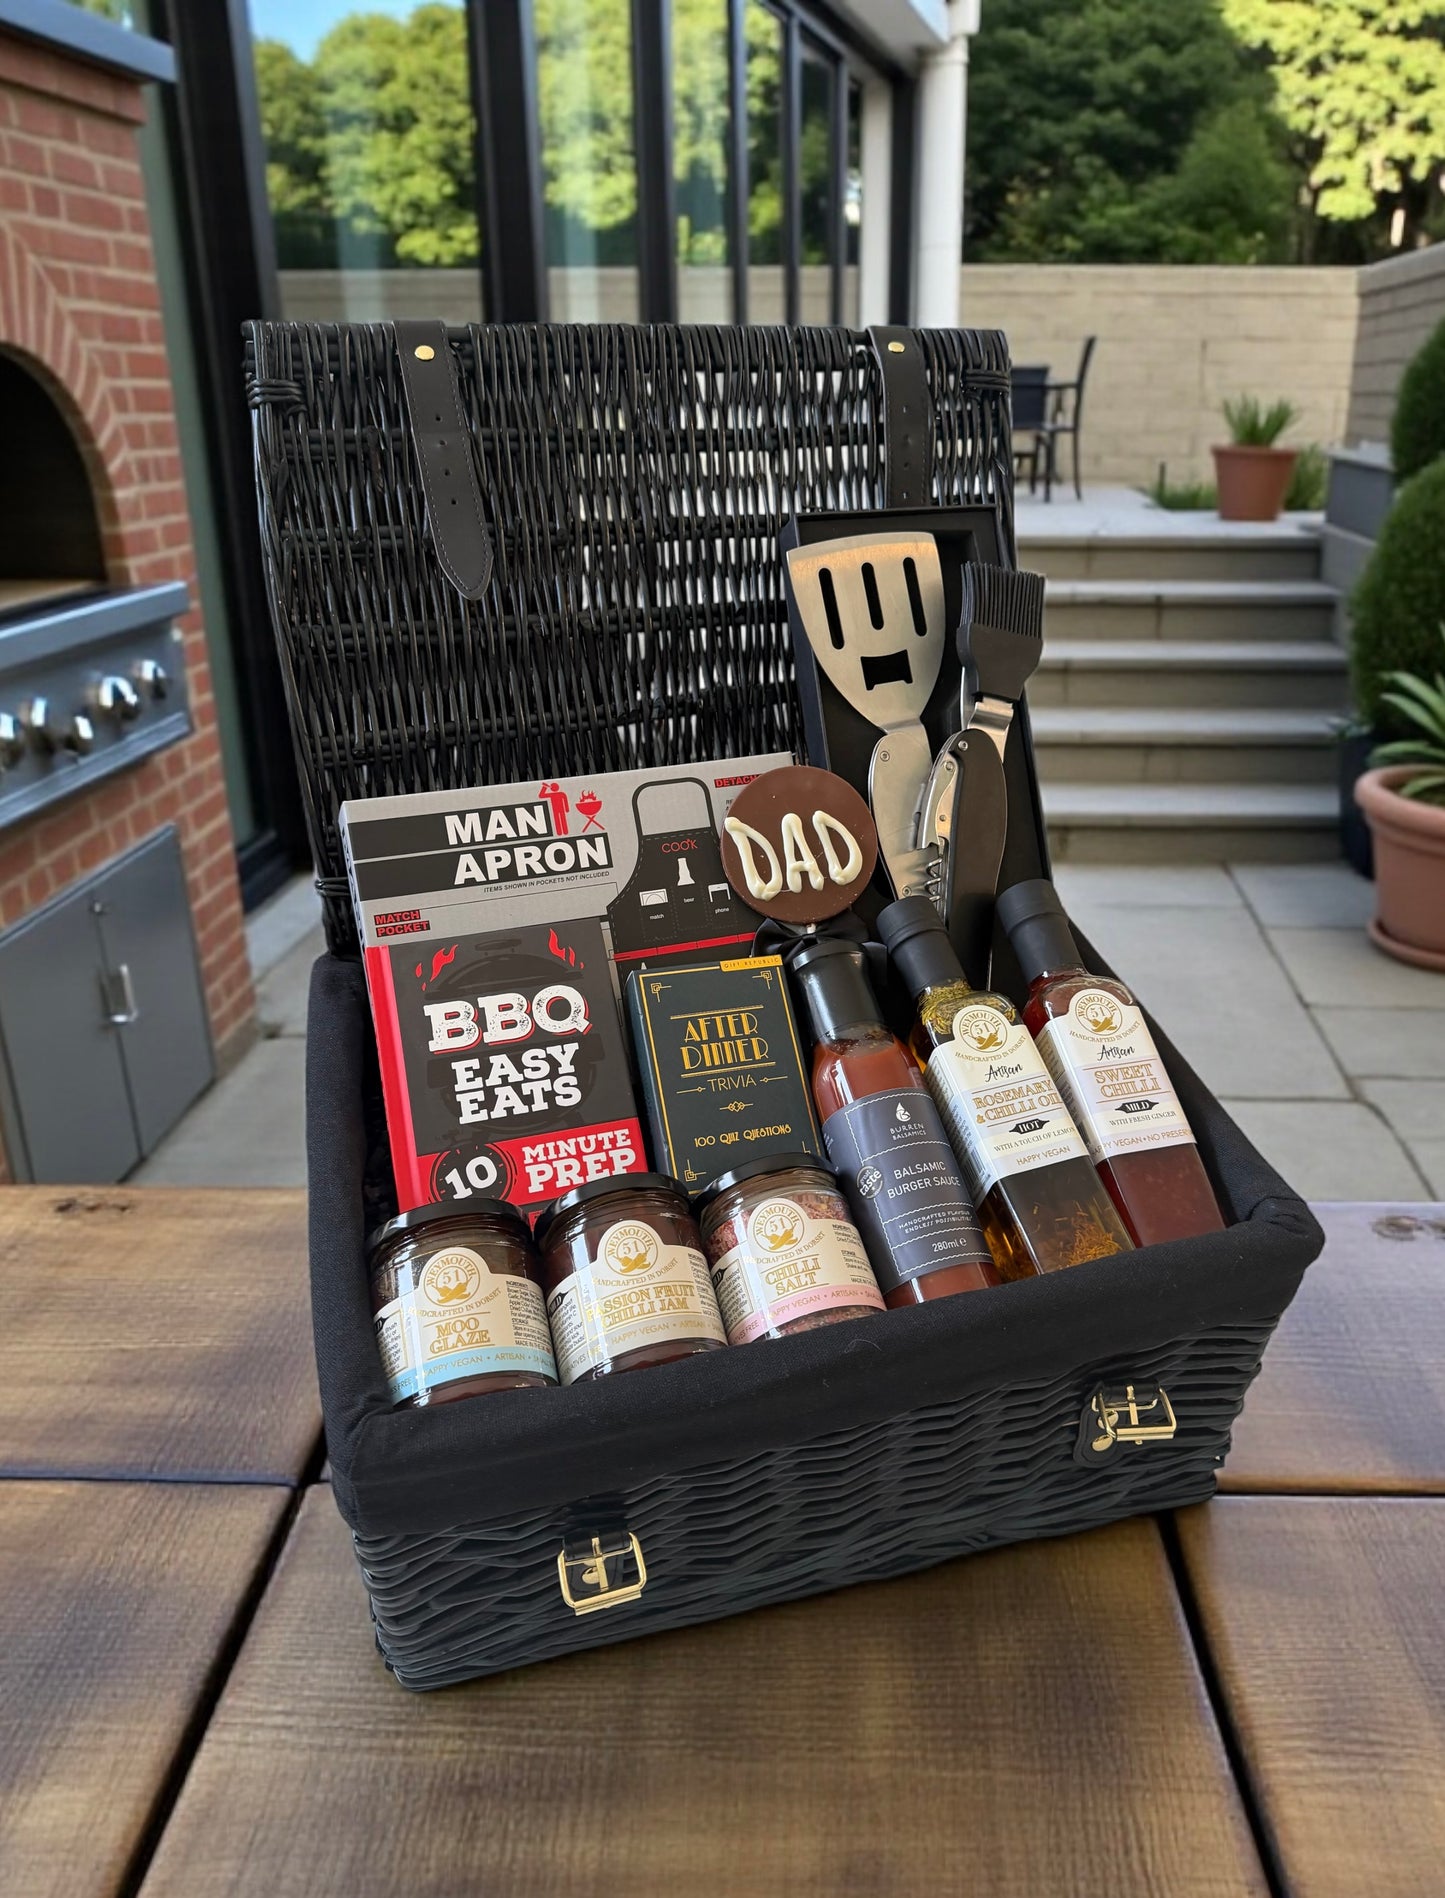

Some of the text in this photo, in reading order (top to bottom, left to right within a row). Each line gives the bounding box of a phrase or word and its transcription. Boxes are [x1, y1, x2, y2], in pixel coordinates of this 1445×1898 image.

[445, 805, 548, 845] MAN
[661, 839, 698, 853] COOK
[724, 810, 863, 901] DAD
[454, 837, 609, 885] APRON
[504, 882, 528, 890] SHOWN
[536, 877, 565, 886] POCKETS
[579, 871, 610, 880] INCLUDED
[375, 911, 420, 925] MATCH
[715, 906, 730, 914] phone
[377, 922, 429, 936] POCKET
[723, 957, 780, 970] GIFT REPUBLIC
[1077, 996, 1118, 1018] WEYMOUTH
[423, 985, 592, 1053] BBQ
[684, 1012, 759, 1043] AFTER
[962, 1012, 1003, 1036] WEYMOUTH
[1069, 1030, 1115, 1043] HANDCRAFTED
[1121, 1021, 1141, 1038] DORSET
[680, 1037, 769, 1070] DINNER
[955, 1035, 1026, 1062] HANDCRAFTED IN DORSET
[1097, 1044, 1135, 1062] Artisan
[451, 1042, 580, 1092] EASY
[985, 1063, 1024, 1082] Artisan
[1094, 1063, 1154, 1084] SWEET
[707, 1074, 757, 1092] TRIVIA
[1100, 1077, 1161, 1098] CHILLI
[455, 1075, 582, 1125] EATS
[972, 1079, 1056, 1110] ROSEMARY
[976, 1114, 985, 1124] &
[984, 1098, 1035, 1121] CHILLI
[1125, 1101, 1150, 1112] MILD
[889, 1123, 924, 1135] BURREN
[1018, 1120, 1040, 1133] HOT
[1109, 1110, 1177, 1127] WITH FRESH GINGER
[522, 1128, 631, 1165] MINUTE
[694, 1124, 792, 1148] 100 QUIZ QUESTIONS
[892, 1130, 927, 1142] BALSAMICS
[993, 1126, 1076, 1152] WITH A TOUCH OF LEMON
[1113, 1136, 1142, 1147] VEGAN
[1016, 1145, 1071, 1166] HAPPY VEGAN
[444, 1155, 498, 1200] 10
[525, 1148, 636, 1193] PREP
[893, 1161, 947, 1180] BALSAMIC
[860, 1170, 882, 1196] taste
[887, 1178, 932, 1200] BURGER
[934, 1176, 961, 1188] SAUCE
[756, 1205, 800, 1236] WEYMOUTH
[770, 1217, 786, 1232] 51
[898, 1211, 946, 1228] HANDCRAFTED
[904, 1222, 934, 1234] ENDLESS
[607, 1228, 654, 1257] WEYMOUTH
[622, 1240, 639, 1256] 51
[803, 1231, 826, 1250] DORSET
[932, 1239, 960, 1252] 280ml
[427, 1256, 477, 1287] WEYMOUTH
[442, 1269, 460, 1284] 51
[656, 1258, 678, 1278] DORSET
[765, 1258, 822, 1284] CHILLI
[776, 1272, 816, 1296] SALT
[465, 1303, 474, 1312] IN
[475, 1288, 502, 1308] DORSET
[585, 1288, 650, 1322] PASSION
[653, 1284, 695, 1298] FRUIT
[792, 1295, 820, 1308] VEGAN
[831, 1290, 858, 1298] ARTISAN
[602, 1298, 690, 1328] CHILLI JAM
[436, 1316, 480, 1339] MOO
[611, 1328, 638, 1344] HAPPY
[639, 1322, 670, 1335] VEGAN
[746, 1320, 760, 1332] FREE
[429, 1330, 491, 1354] GLAZE
[450, 1356, 482, 1368] VEGAN
[494, 1352, 525, 1360] ARTISAN
